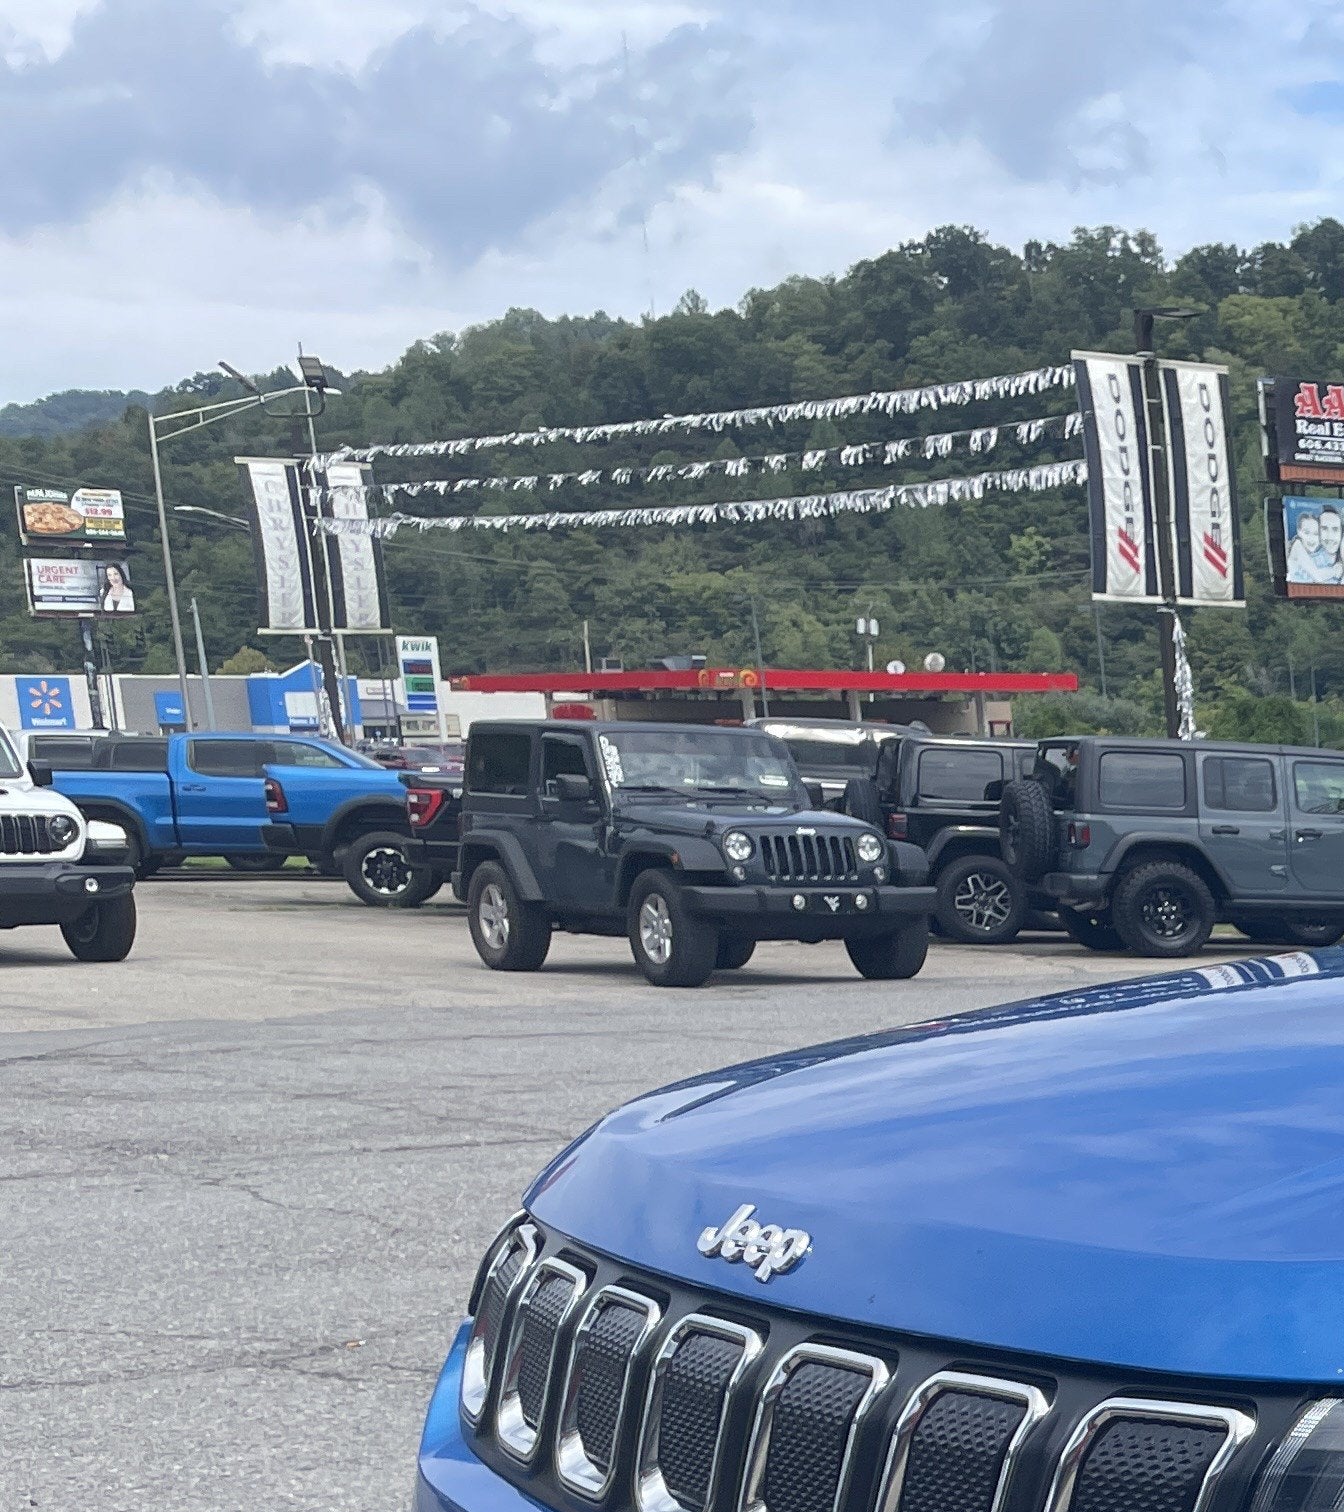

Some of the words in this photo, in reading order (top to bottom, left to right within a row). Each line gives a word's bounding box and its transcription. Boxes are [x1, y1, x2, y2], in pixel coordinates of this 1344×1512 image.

[1295, 419, 1331, 436] Real
[1107, 373, 1138, 546] DODGE
[1199, 382, 1223, 551] DODGE
[37, 566, 78, 574] URGENT
[38, 575, 65, 583] CARE
[697, 1204, 811, 1283] Jeep
